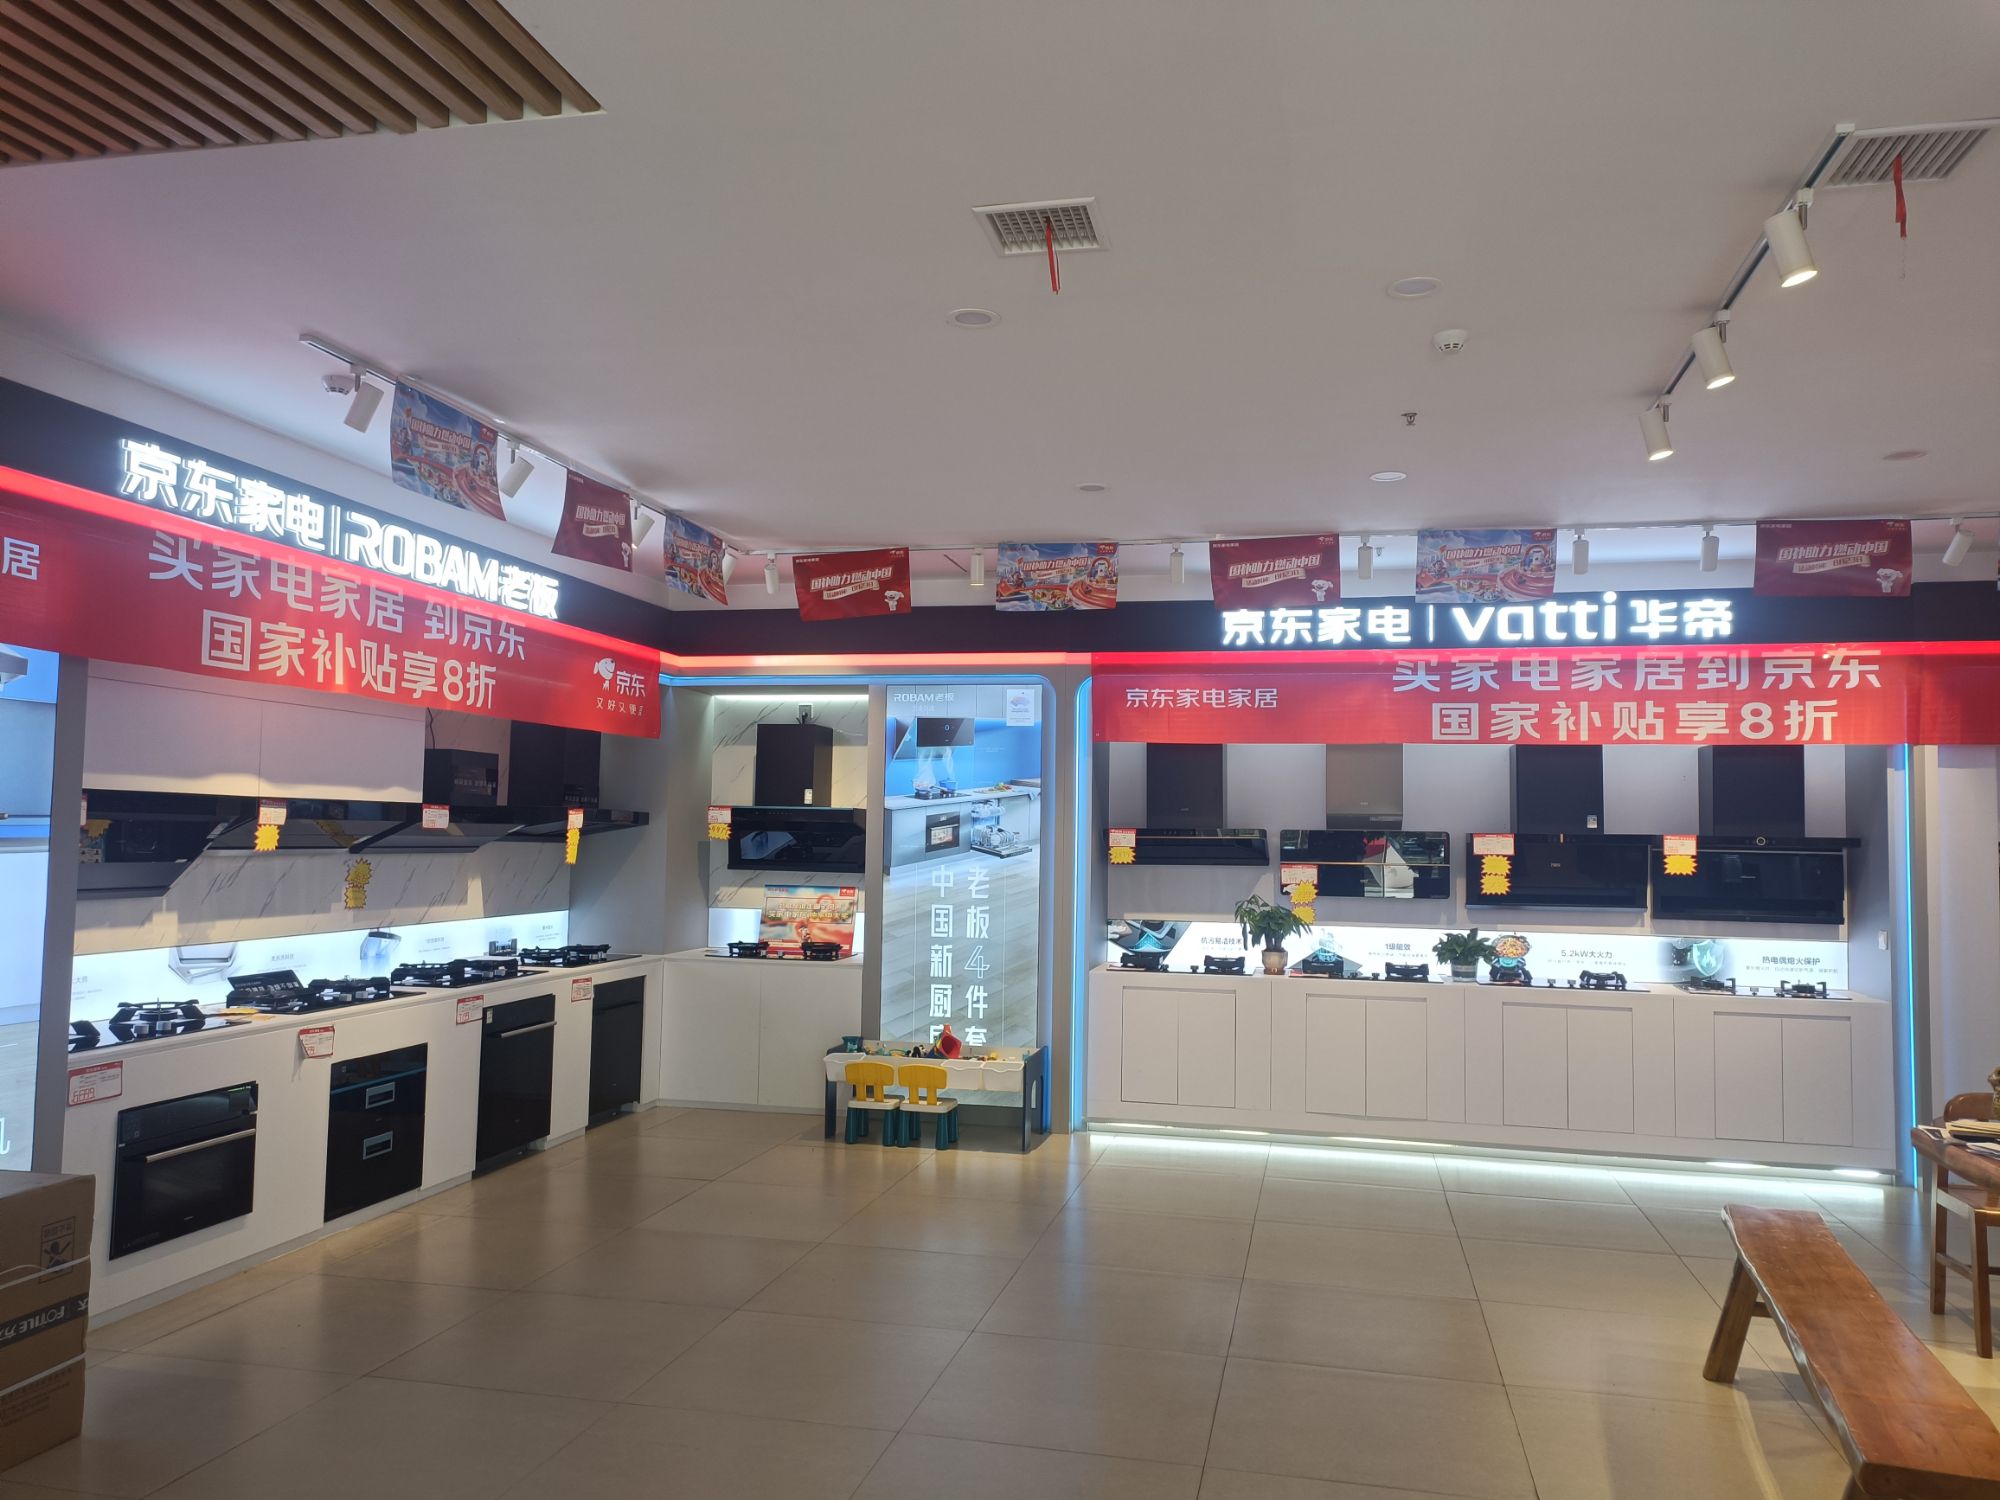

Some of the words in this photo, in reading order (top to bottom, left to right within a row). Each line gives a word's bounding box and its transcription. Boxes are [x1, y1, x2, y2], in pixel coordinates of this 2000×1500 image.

[119, 439, 326, 549] 京东家电
[348, 514, 502, 600] ROBAM
[498, 563, 559, 619] 老板
[2, 537, 40, 580] 居
[1222, 607, 1411, 645] 京东家电
[1452, 591, 1618, 641] vatti
[1629, 598, 1734, 640] 华帝
[201, 610, 497, 710] 国家补贴享8折
[1394, 649, 1882, 692] 买家电家居到京东
[616, 671, 646, 697] 京东
[1125, 688, 1279, 708] 京东家电家居
[1432, 699, 1839, 743] 国家补贴享8折
[19, 1305, 66, 1334] FOTILE
